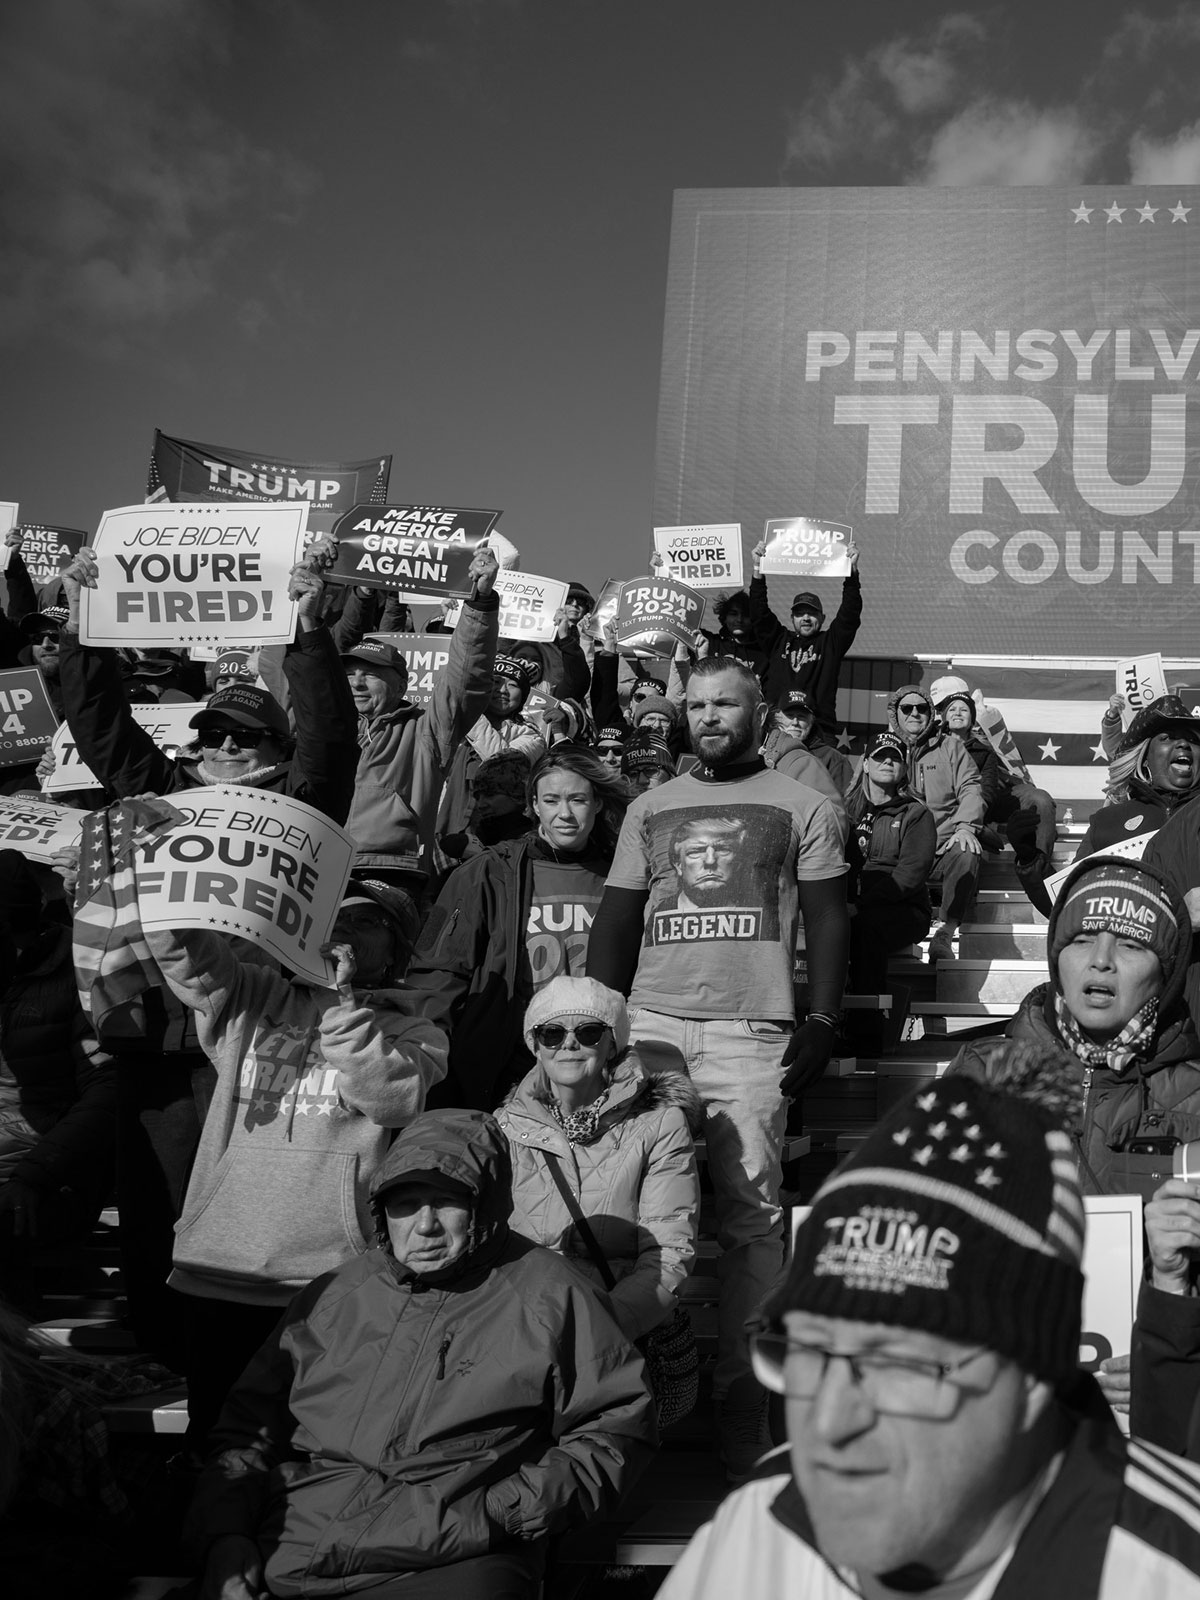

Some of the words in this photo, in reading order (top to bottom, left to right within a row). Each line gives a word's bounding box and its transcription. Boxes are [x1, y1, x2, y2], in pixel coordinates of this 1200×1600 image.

[203, 460, 341, 500] TRUMP
[208, 485, 234, 495] MAKE
[235, 490, 274, 503] AMERICA
[382, 509, 459, 525] MAKE
[123, 526, 175, 547] JOE
[178, 526, 261, 548] BIDEN,
[352, 518, 467, 544] AMERICA
[772, 528, 845, 544] TRUMP
[22, 540, 71, 555] ERICA
[362, 534, 450, 561] GREAT
[668, 537, 690, 548] JOE
[690, 536, 723, 547] BIDEN,
[781, 543, 833, 558] 2024
[20, 553, 60, 567] REAT
[667, 548, 726, 563] YOU'RE
[28, 565, 61, 576] AIN!
[115, 553, 262, 583] YOU'RE
[356, 553, 449, 583] AGAIN!
[668, 563, 732, 579] FIRED!
[116, 590, 273, 623] FIRED!
[500, 594, 544, 613] U'RE
[625, 587, 698, 612] TRUMP
[632, 601, 687, 622] 2024
[500, 613, 545, 632] RED!
[621, 617, 637, 629] TEXT
[665, 617, 676, 625] TO
[220, 662, 250, 675] 202
[399, 651, 449, 670] UMP
[406, 673, 434, 692] 24
[637, 681, 664, 695] TRUMP
[1125, 664, 1143, 712] TRU
[1140, 676, 1154, 702] VO
[227, 688, 265, 705] AMERICA
[231, 695, 260, 710] AGAIN
[627, 749, 657, 761] TRUMP
[175, 807, 226, 829] OE
[226, 810, 323, 863] BIDEN,
[137, 834, 321, 904] YOU'RE
[137, 871, 316, 951] FIRED!
[527, 903, 597, 933] RUM
[1085, 896, 1157, 925] TRUMP
[657, 913, 756, 942] LEGEND
[1082, 919, 1105, 931] SAVE
[1107, 922, 1152, 943] AMERICA!
[525, 933, 591, 985] 02
[823, 1212, 961, 1261] TRUMP
